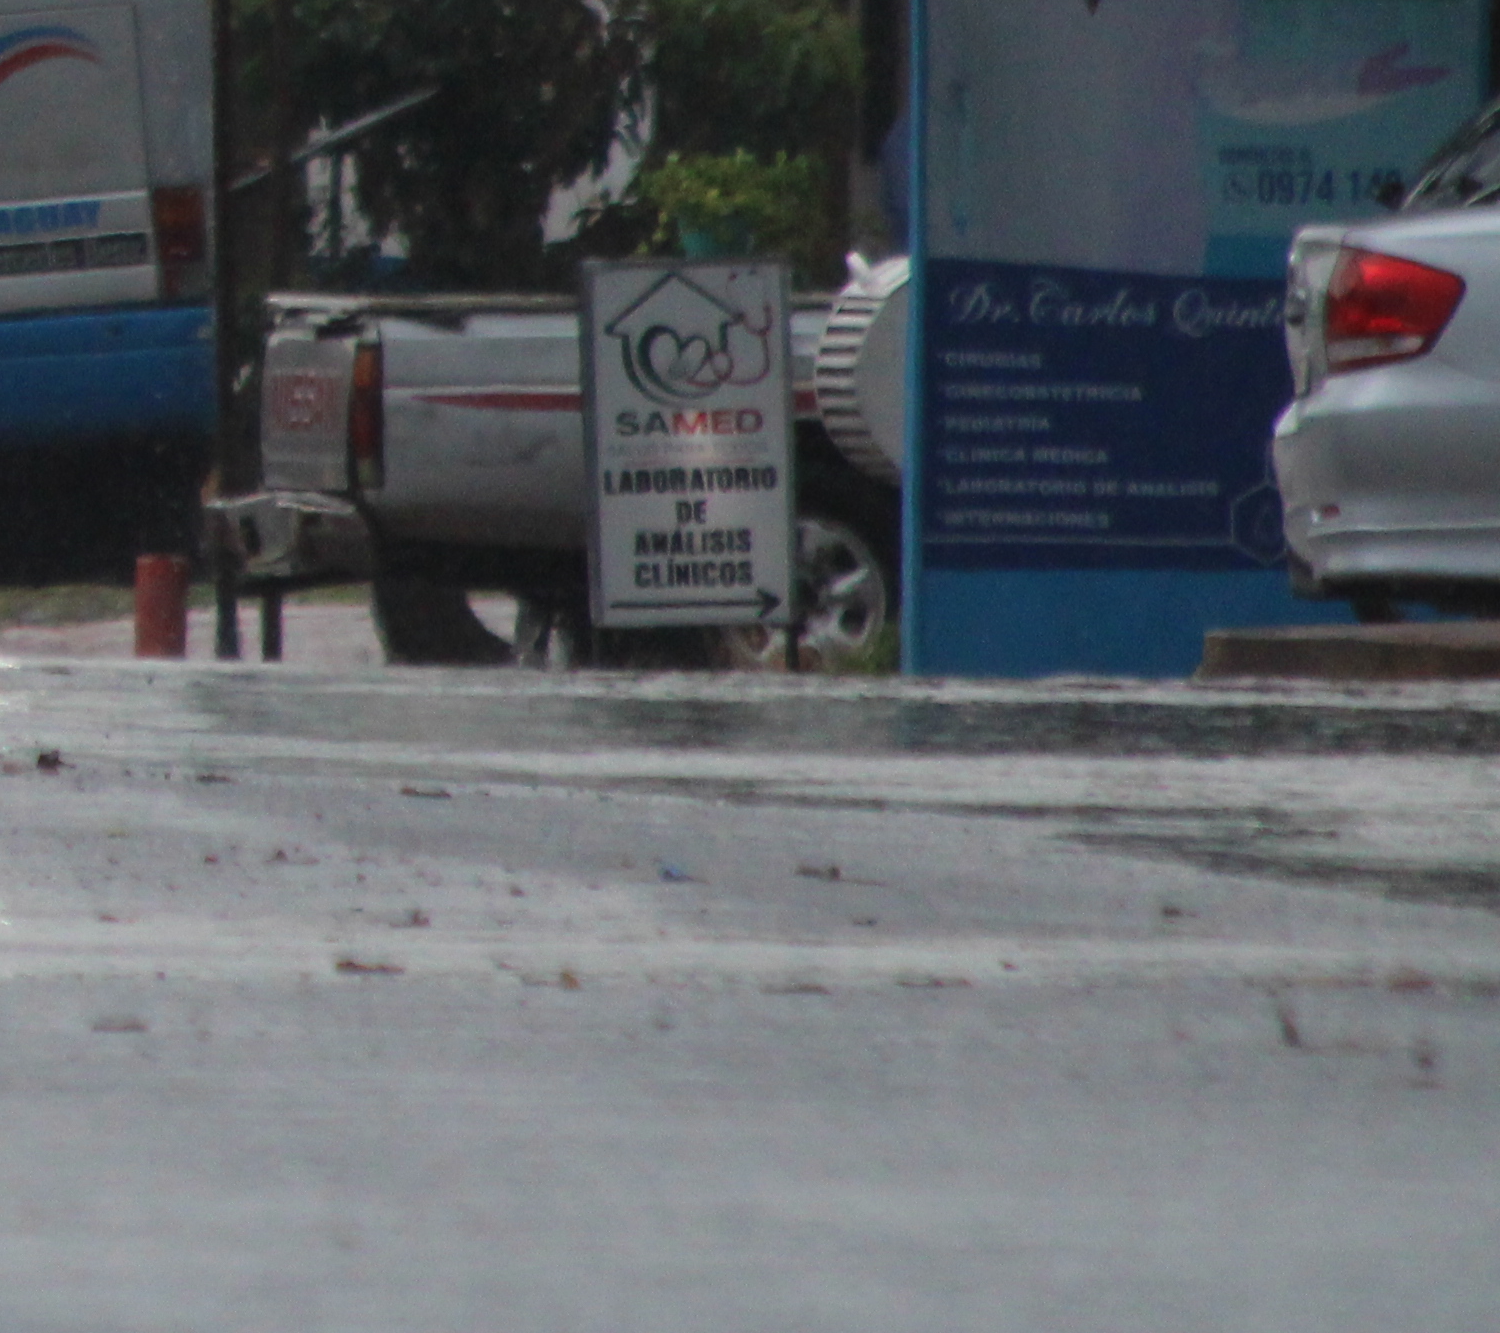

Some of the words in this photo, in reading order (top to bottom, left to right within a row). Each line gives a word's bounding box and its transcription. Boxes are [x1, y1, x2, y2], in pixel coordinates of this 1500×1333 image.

[615, 408, 764, 436] SAMED
[603, 465, 778, 496] LABORATORIO
[674, 499, 708, 525] DE
